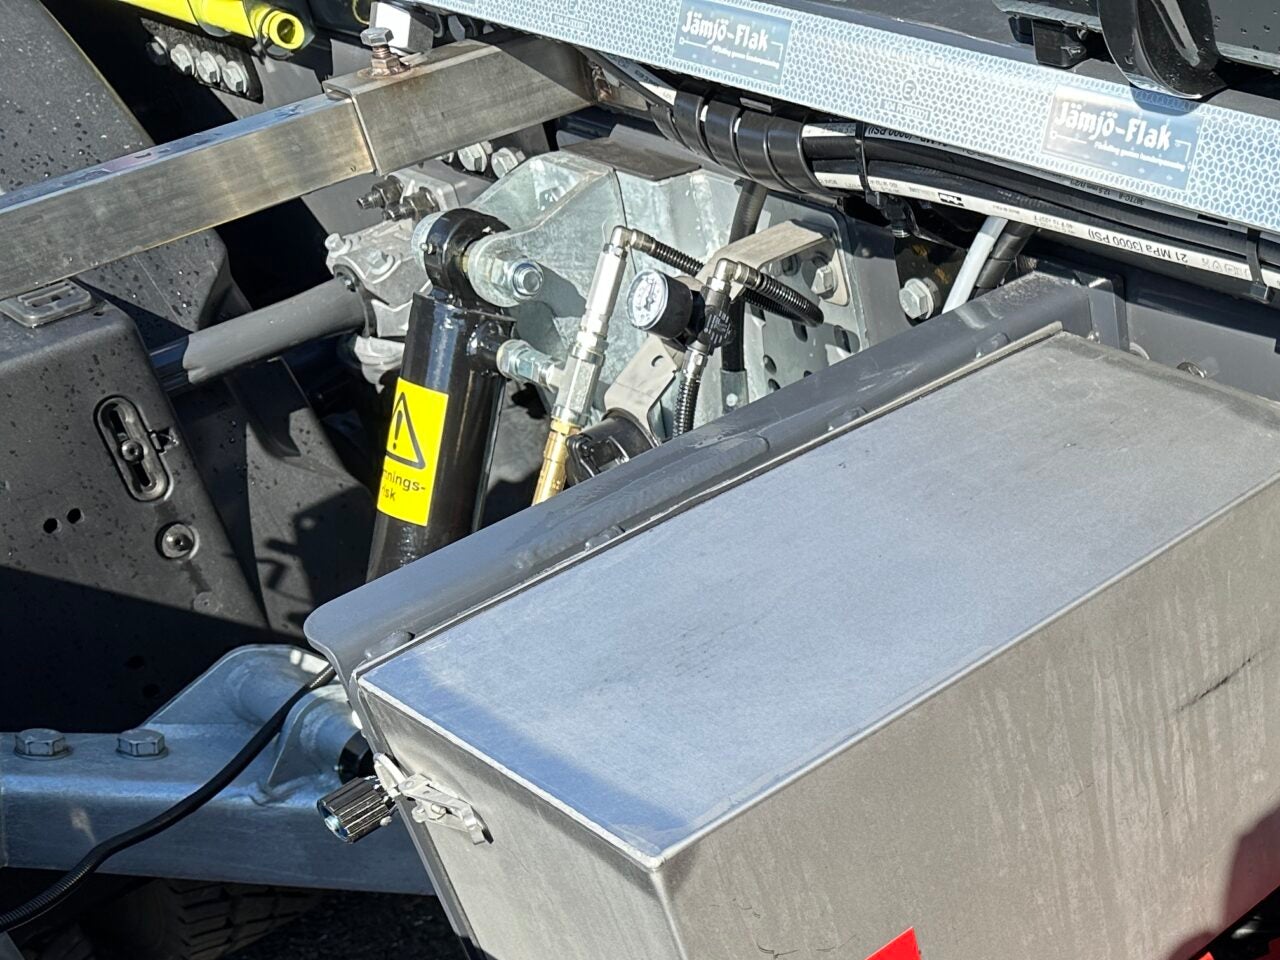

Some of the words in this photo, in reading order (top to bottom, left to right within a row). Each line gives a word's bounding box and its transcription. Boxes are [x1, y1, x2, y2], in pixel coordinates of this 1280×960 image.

[682, 10, 769, 51] Jämjö-Flak
[1054, 101, 1172, 151] Jämjö-Flak
[1088, 228, 1110, 243] PSI)
[1112, 236, 1143, 252] (3000
[1145, 244, 1172, 259] MPa
[1175, 251, 1188, 263] 21
